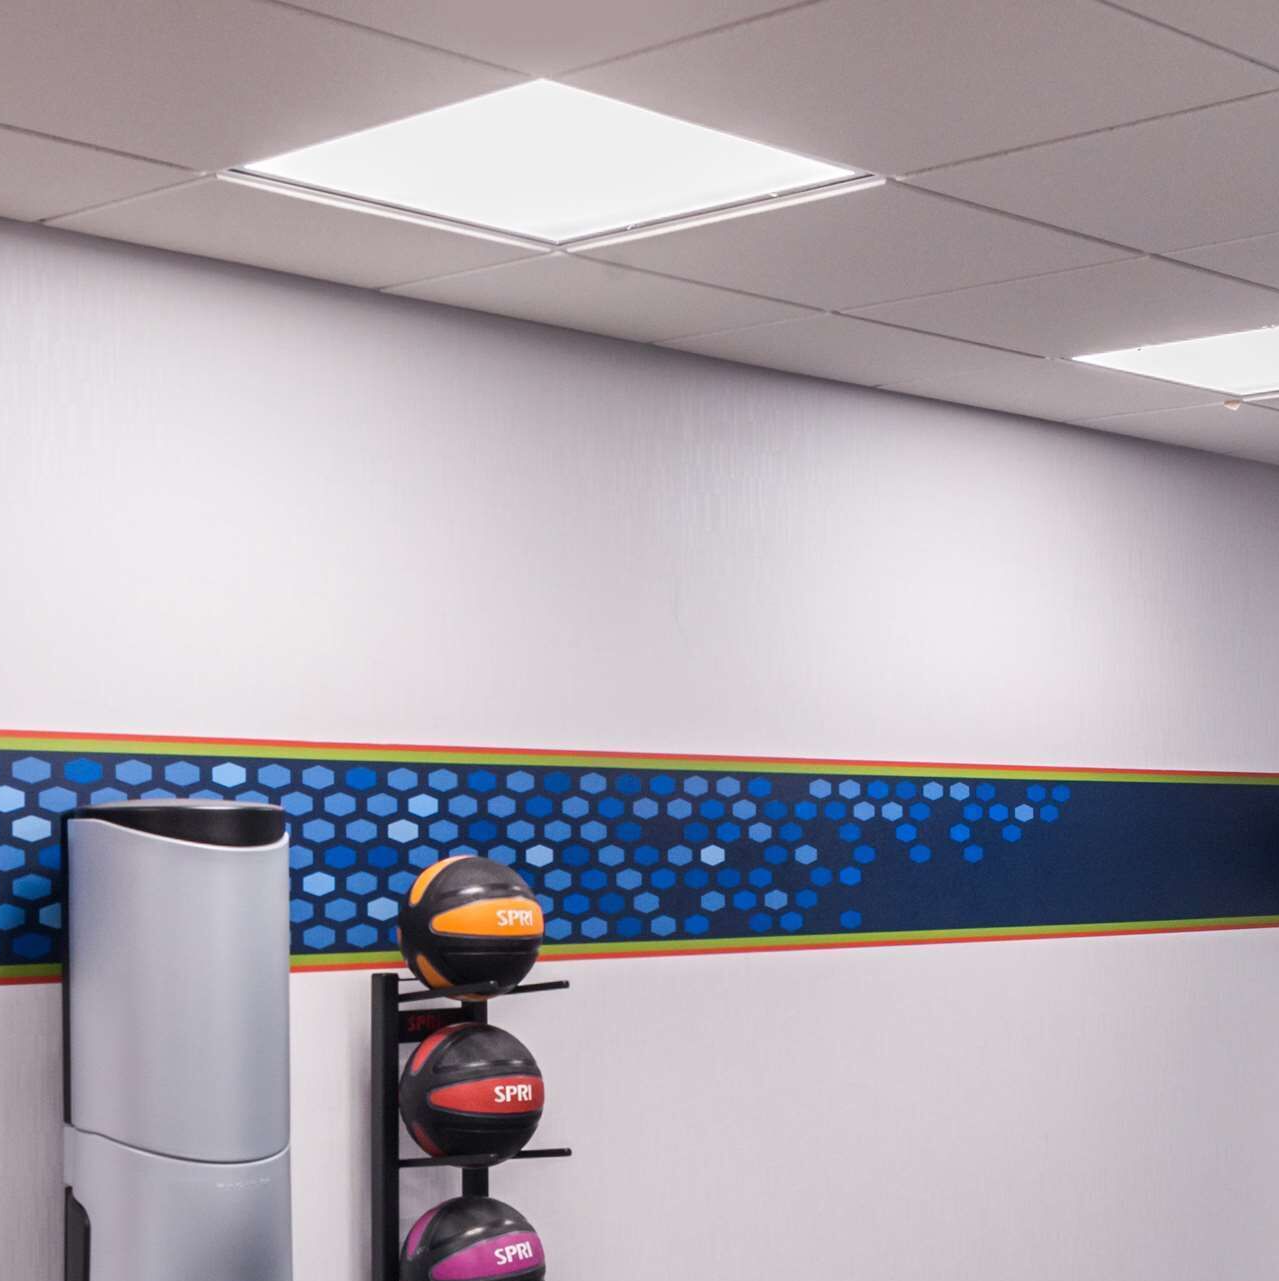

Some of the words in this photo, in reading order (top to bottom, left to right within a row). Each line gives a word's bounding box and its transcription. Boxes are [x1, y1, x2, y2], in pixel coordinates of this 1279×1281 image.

[496, 910, 533, 927] SPRI
[493, 1083, 533, 1103] SPRI
[493, 1240, 534, 1266] SPRI
